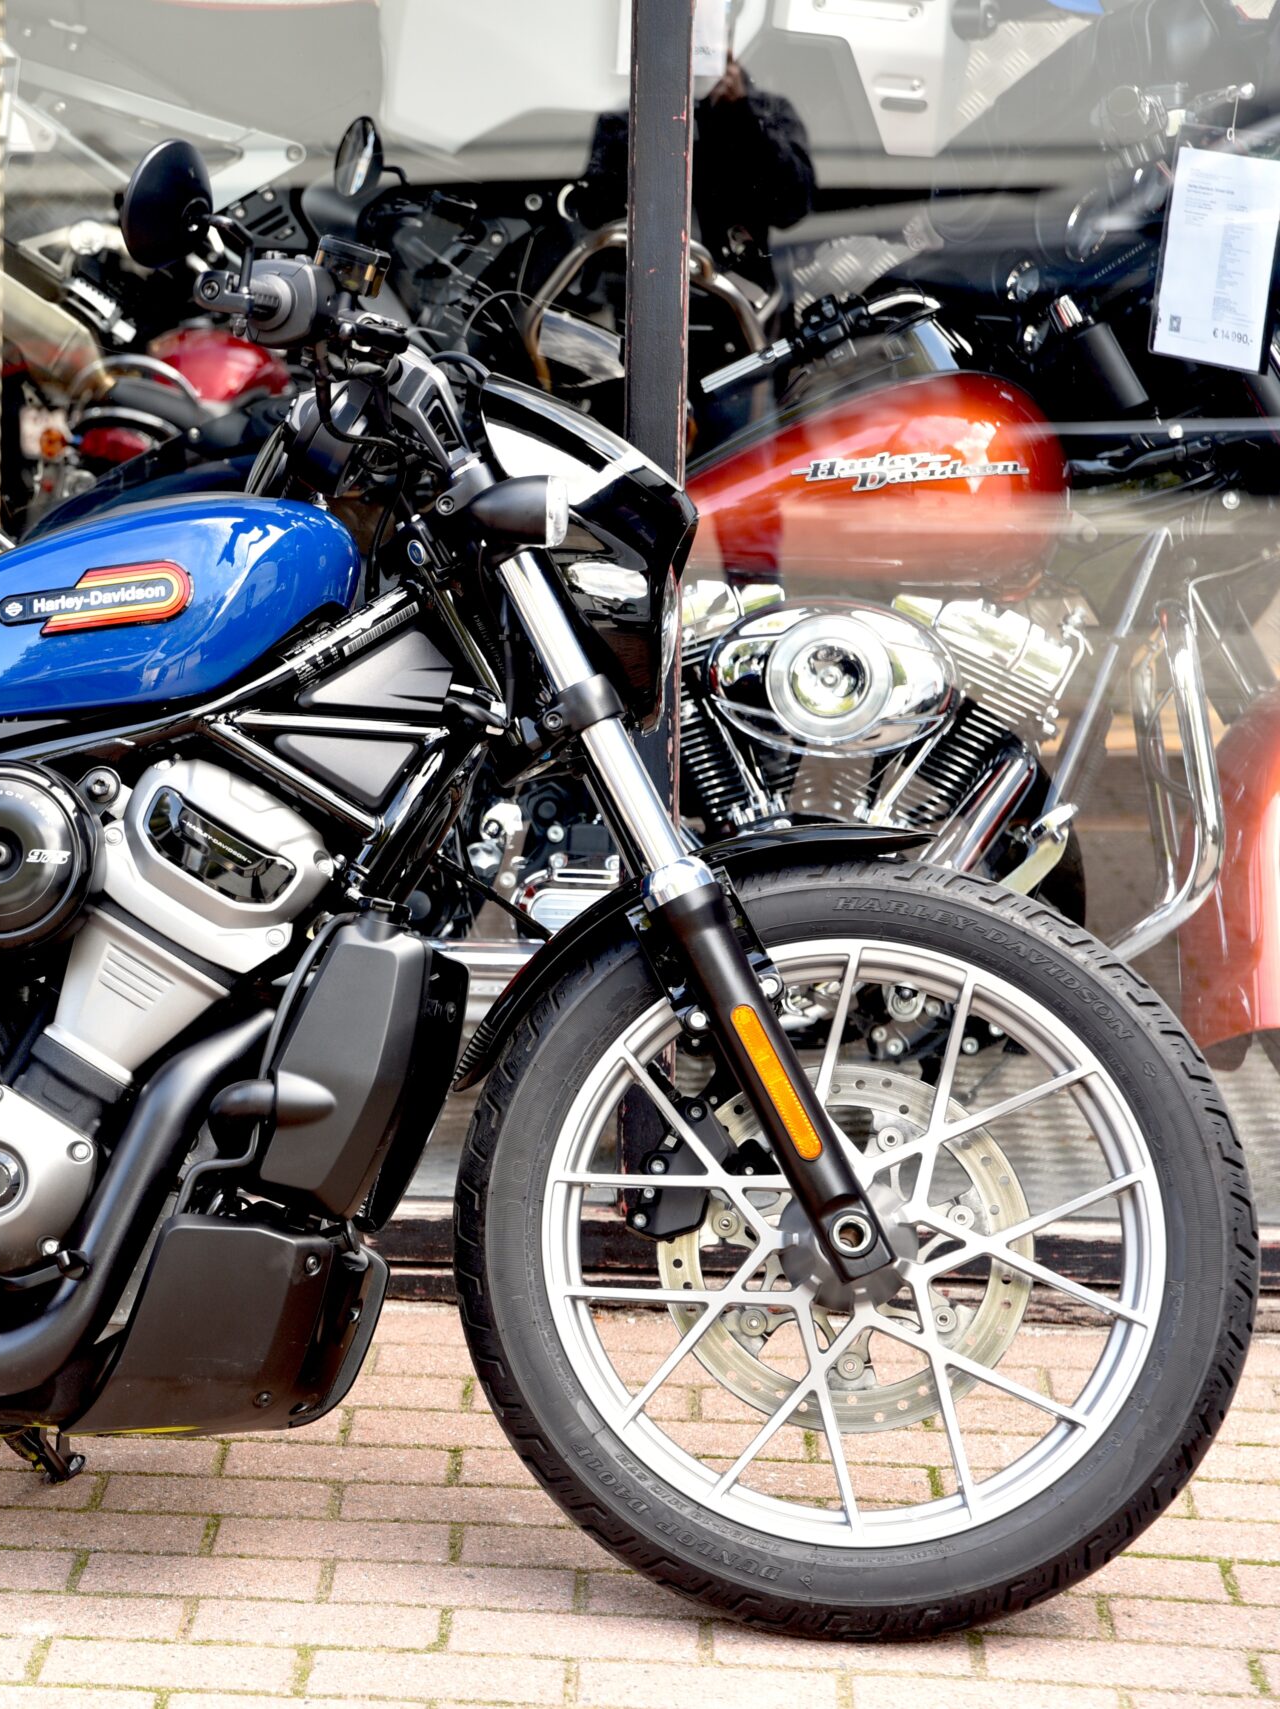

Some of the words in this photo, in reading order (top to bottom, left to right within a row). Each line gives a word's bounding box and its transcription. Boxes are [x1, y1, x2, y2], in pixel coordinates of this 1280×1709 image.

[1212, 327, 1219, 339] €
[33, 584, 166, 614] Harley-Davidson
[832, 895, 1134, 1042] HARLEY-DAVIDSON
[567, 1441, 652, 1515] D401F
[655, 1519, 785, 1582] DUNLOP
